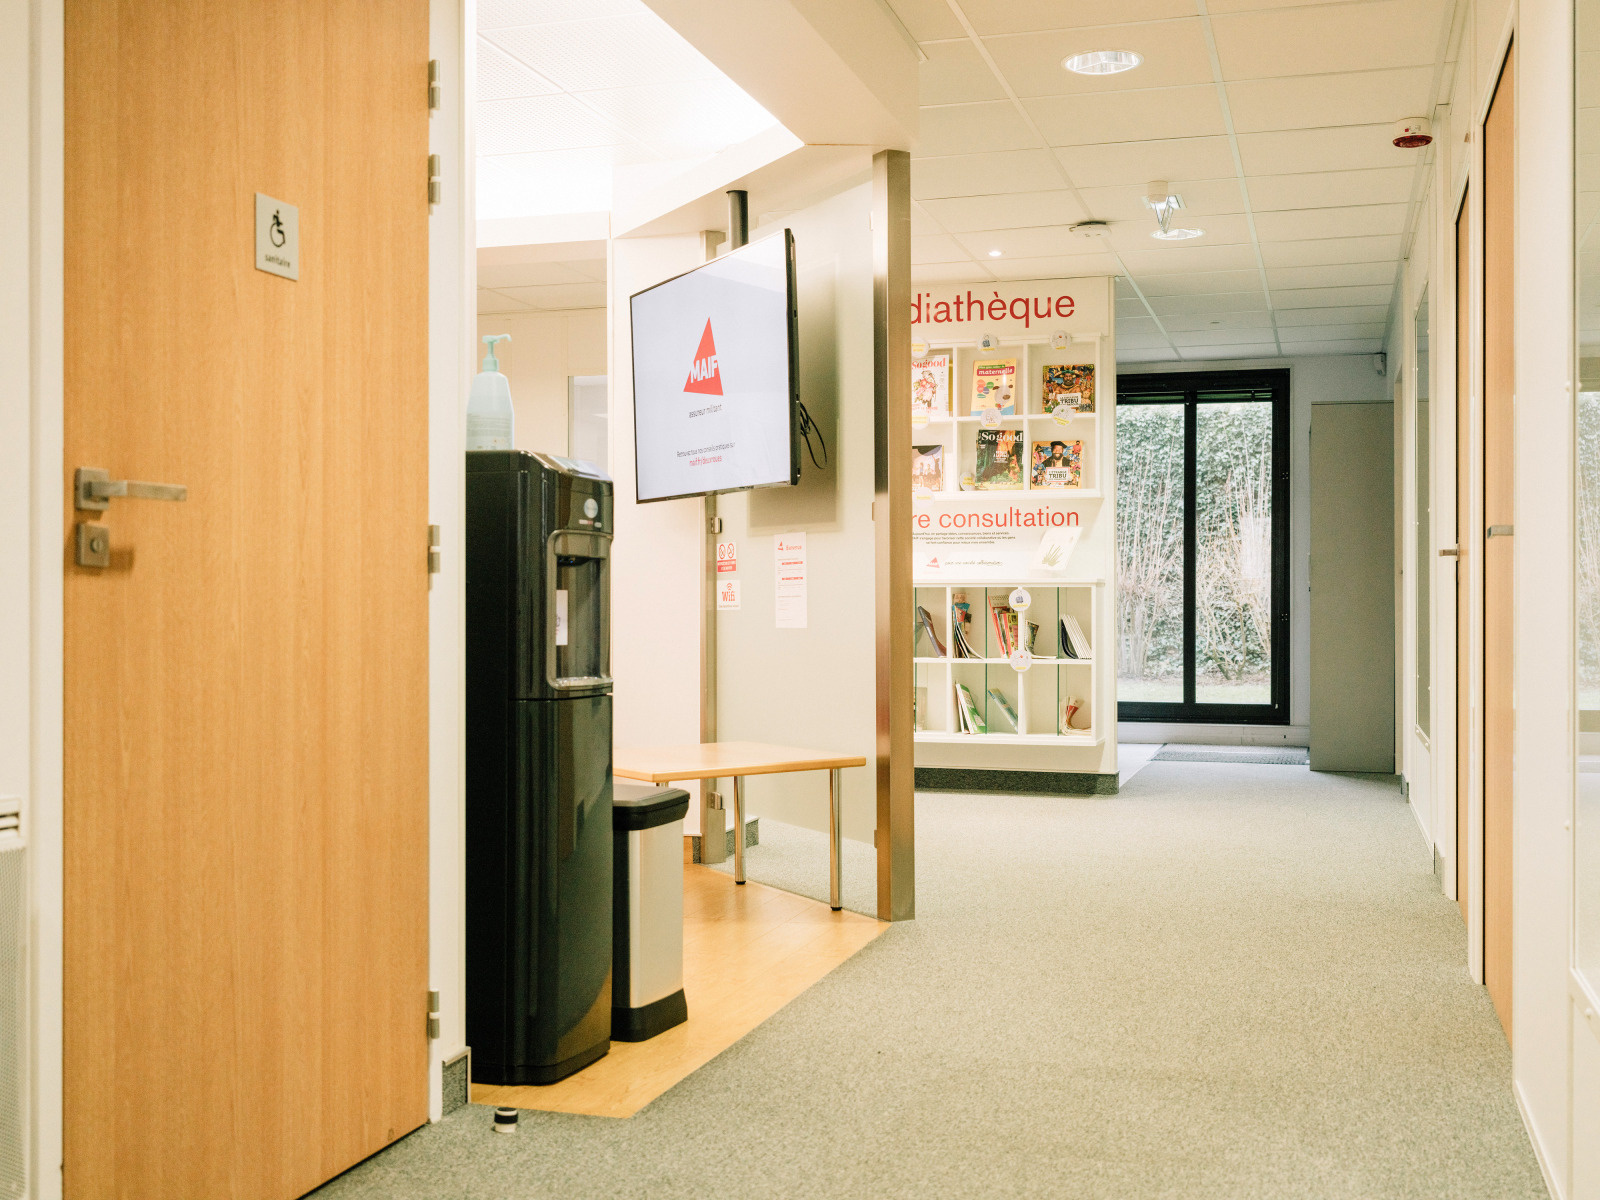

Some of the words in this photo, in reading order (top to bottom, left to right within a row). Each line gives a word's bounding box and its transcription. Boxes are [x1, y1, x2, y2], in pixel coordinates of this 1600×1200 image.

[690, 354, 718, 383] MAIF
[939, 506, 1079, 529] consultation
[721, 590, 736, 601] Wifi
